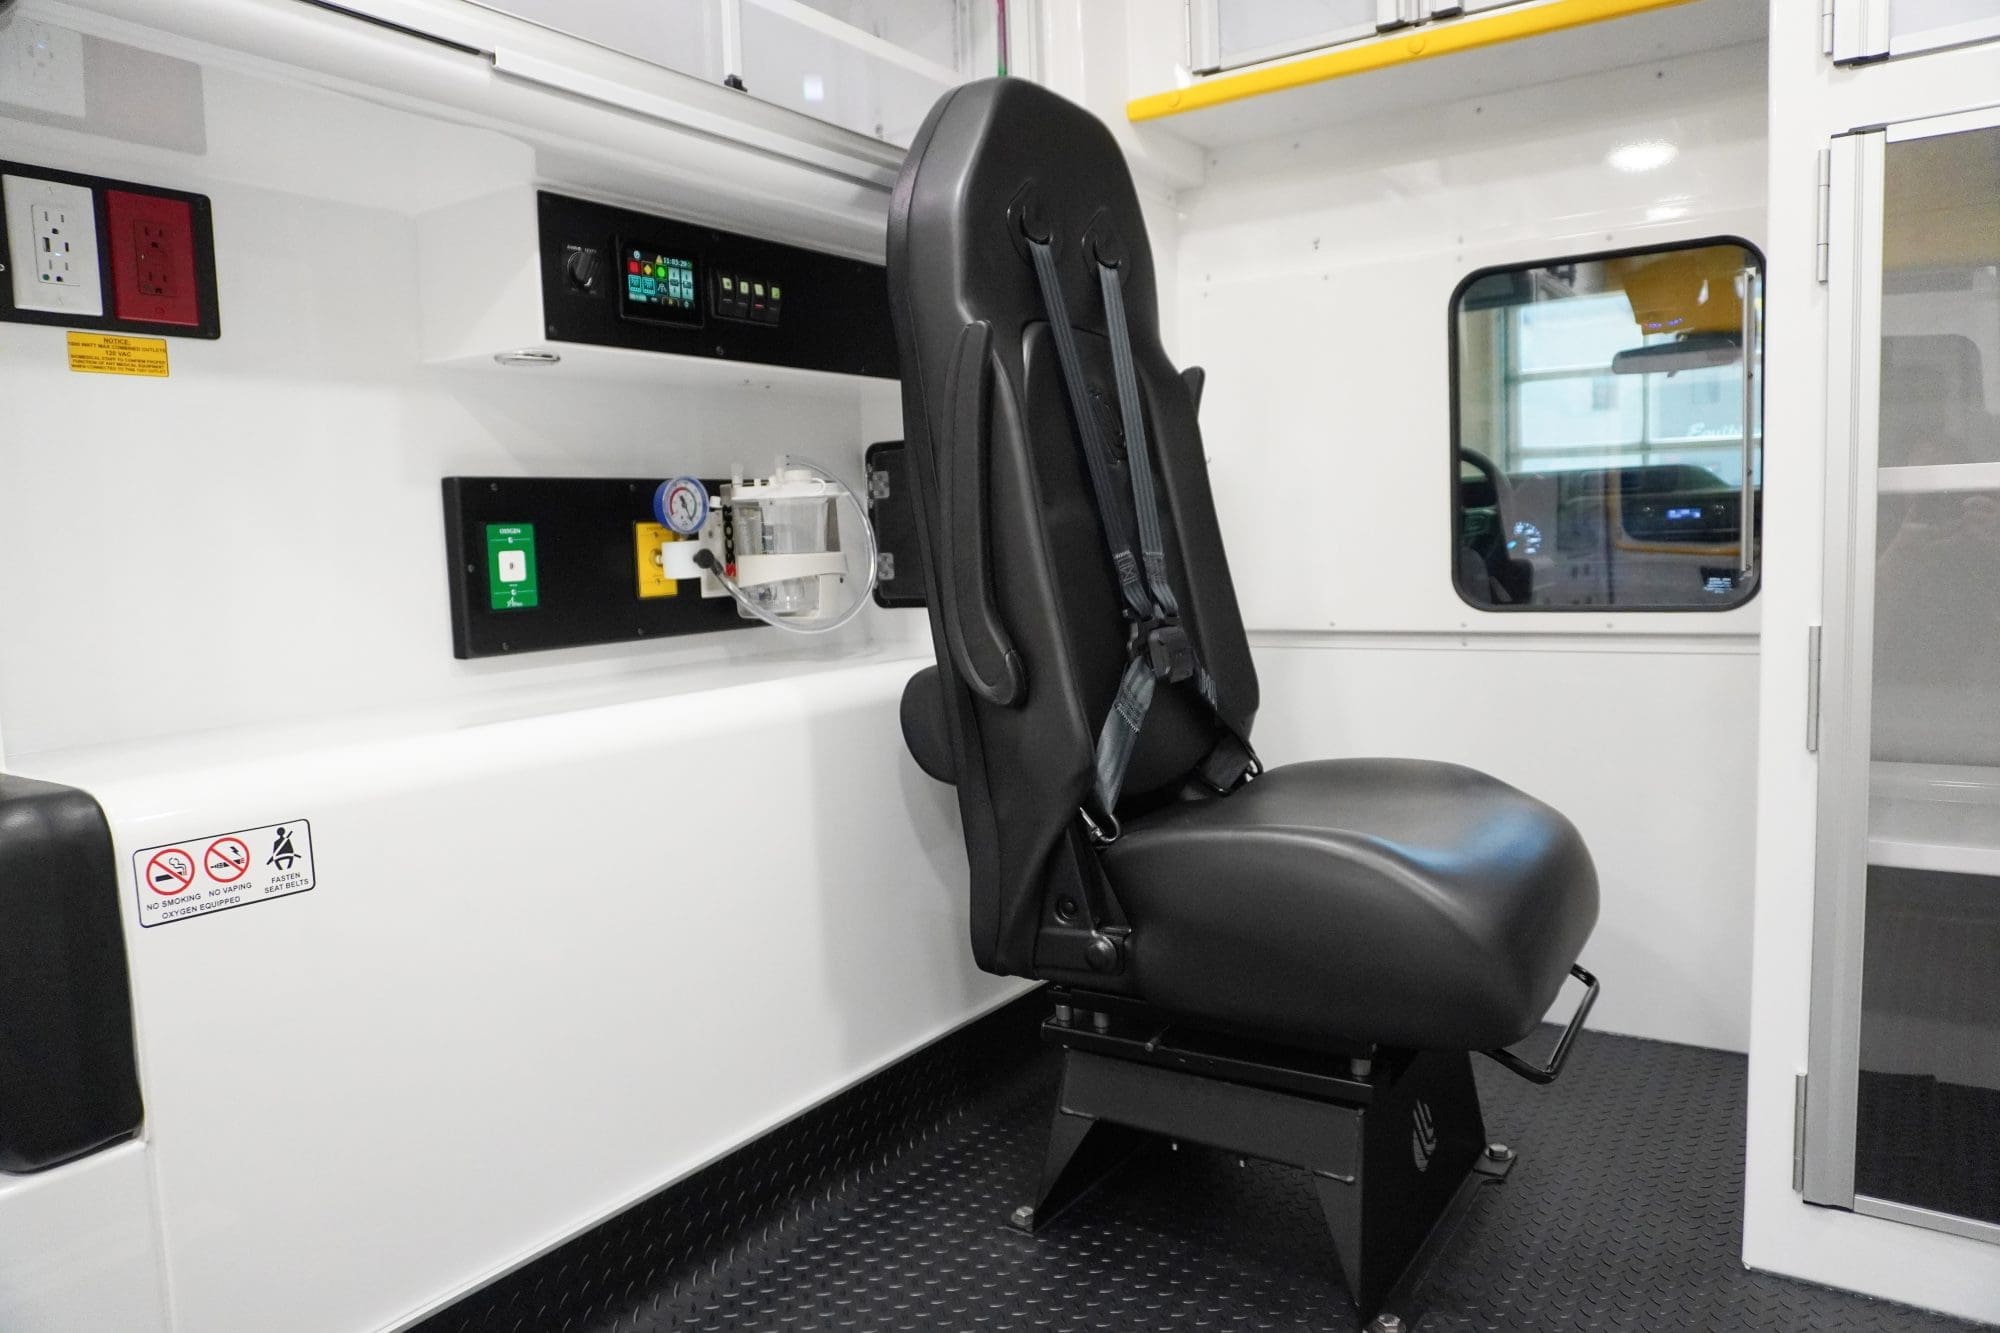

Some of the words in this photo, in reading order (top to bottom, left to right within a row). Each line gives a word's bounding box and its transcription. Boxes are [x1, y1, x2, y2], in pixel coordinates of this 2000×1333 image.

[271, 872, 301, 883] FASTEN
[208, 889, 221, 897] NO
[222, 881, 252, 895] VAPING
[264, 885, 284, 894] SEAT
[285, 878, 309, 890] BELTS
[146, 902, 160, 911] NO
[161, 893, 201, 908] SMOKING
[161, 906, 198, 919] OXYGEN
[199, 896, 241, 911] EQUIPPED
